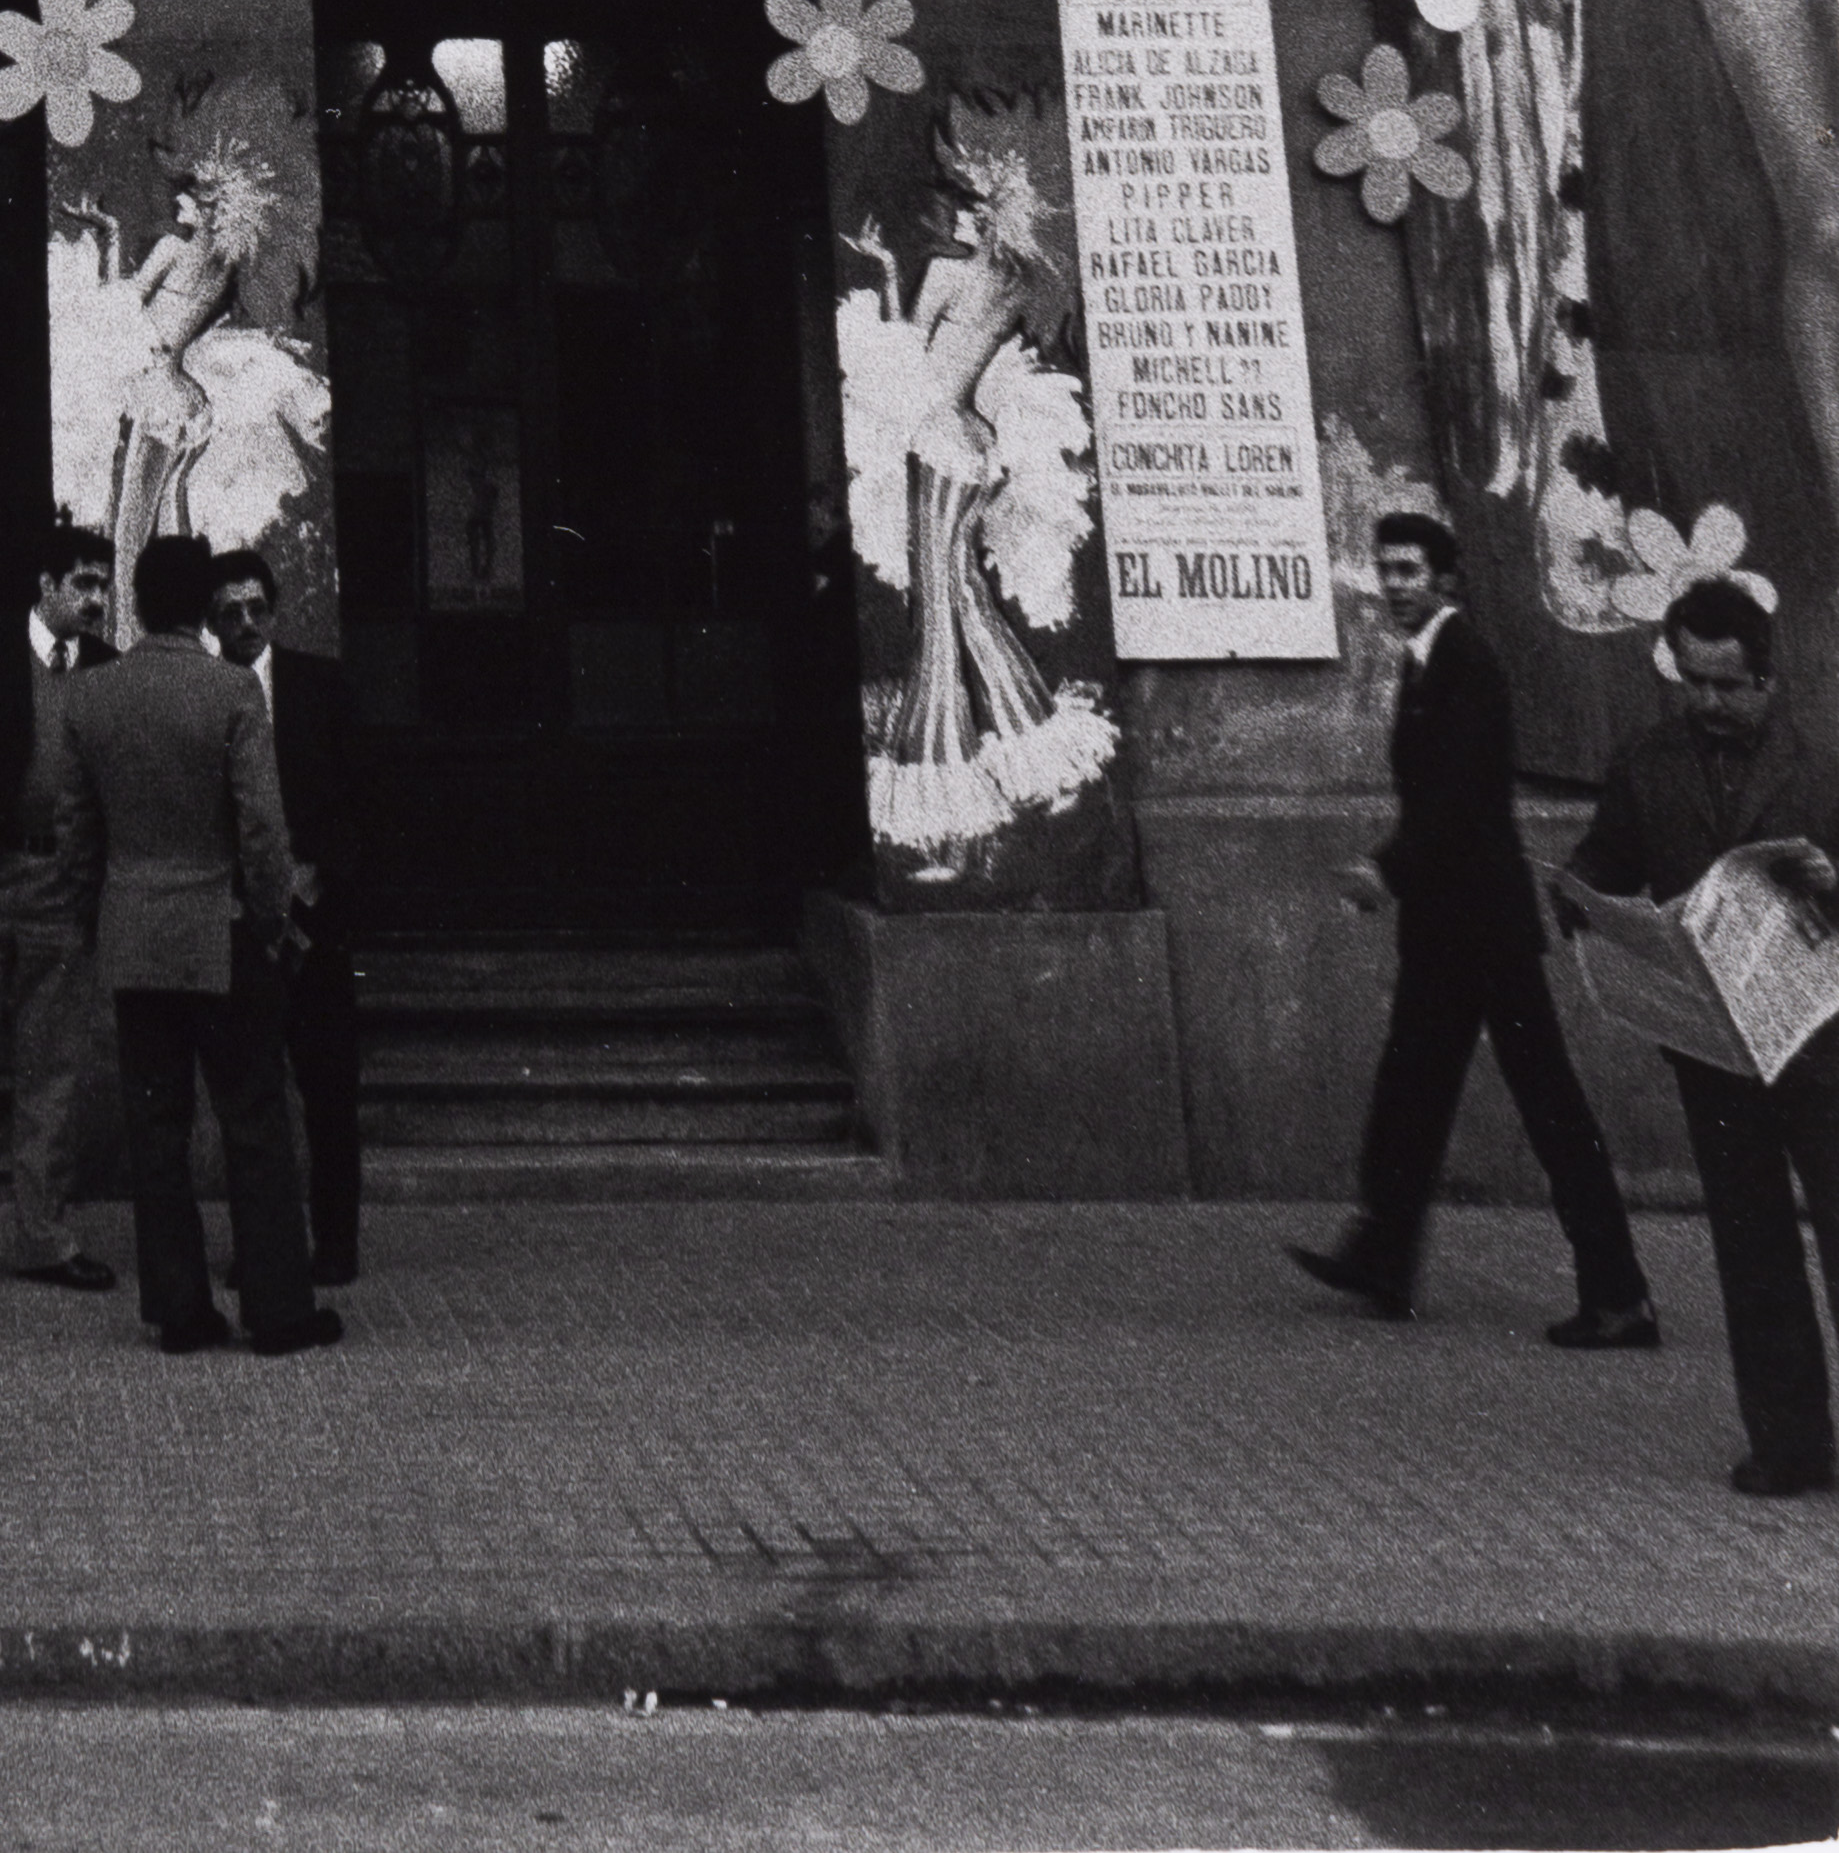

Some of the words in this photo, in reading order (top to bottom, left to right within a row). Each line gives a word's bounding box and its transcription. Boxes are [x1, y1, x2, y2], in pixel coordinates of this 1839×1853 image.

[1097, 11, 1224, 37] MARINETTE
[1073, 49, 1136, 75] ALICIA
[1146, 49, 1171, 75] DE
[1184, 49, 1260, 75] ALZAGA
[1074, 83, 1146, 110] FRANK
[1159, 83, 1263, 110] JOHNSON
[1085, 149, 1175, 176] ANTONIO
[1189, 147, 1271, 175] VARGAS
[1121, 182, 1234, 210] PIPPER
[1109, 216, 1158, 245] LITA
[1172, 215, 1256, 244] CLAVER
[1090, 250, 1179, 280] RAFAEL
[1194, 249, 1281, 276] GARCIA
[1105, 284, 1186, 313] GLORIA
[1198, 283, 1273, 312] PADDY
[1098, 320, 1173, 349] BRUNO
[1184, 320, 1195, 347] Y
[1206, 320, 1290, 348] NANINE
[1133, 356, 1233, 385] MICHELL
[1118, 391, 1207, 420] FONCHO
[1221, 391, 1282, 421] SANS
[1112, 444, 1209, 471] CONCHITA
[1225, 444, 1295, 472] LOREN
[1115, 552, 1163, 599] EL
[1176, 552, 1312, 600] MOLINO
